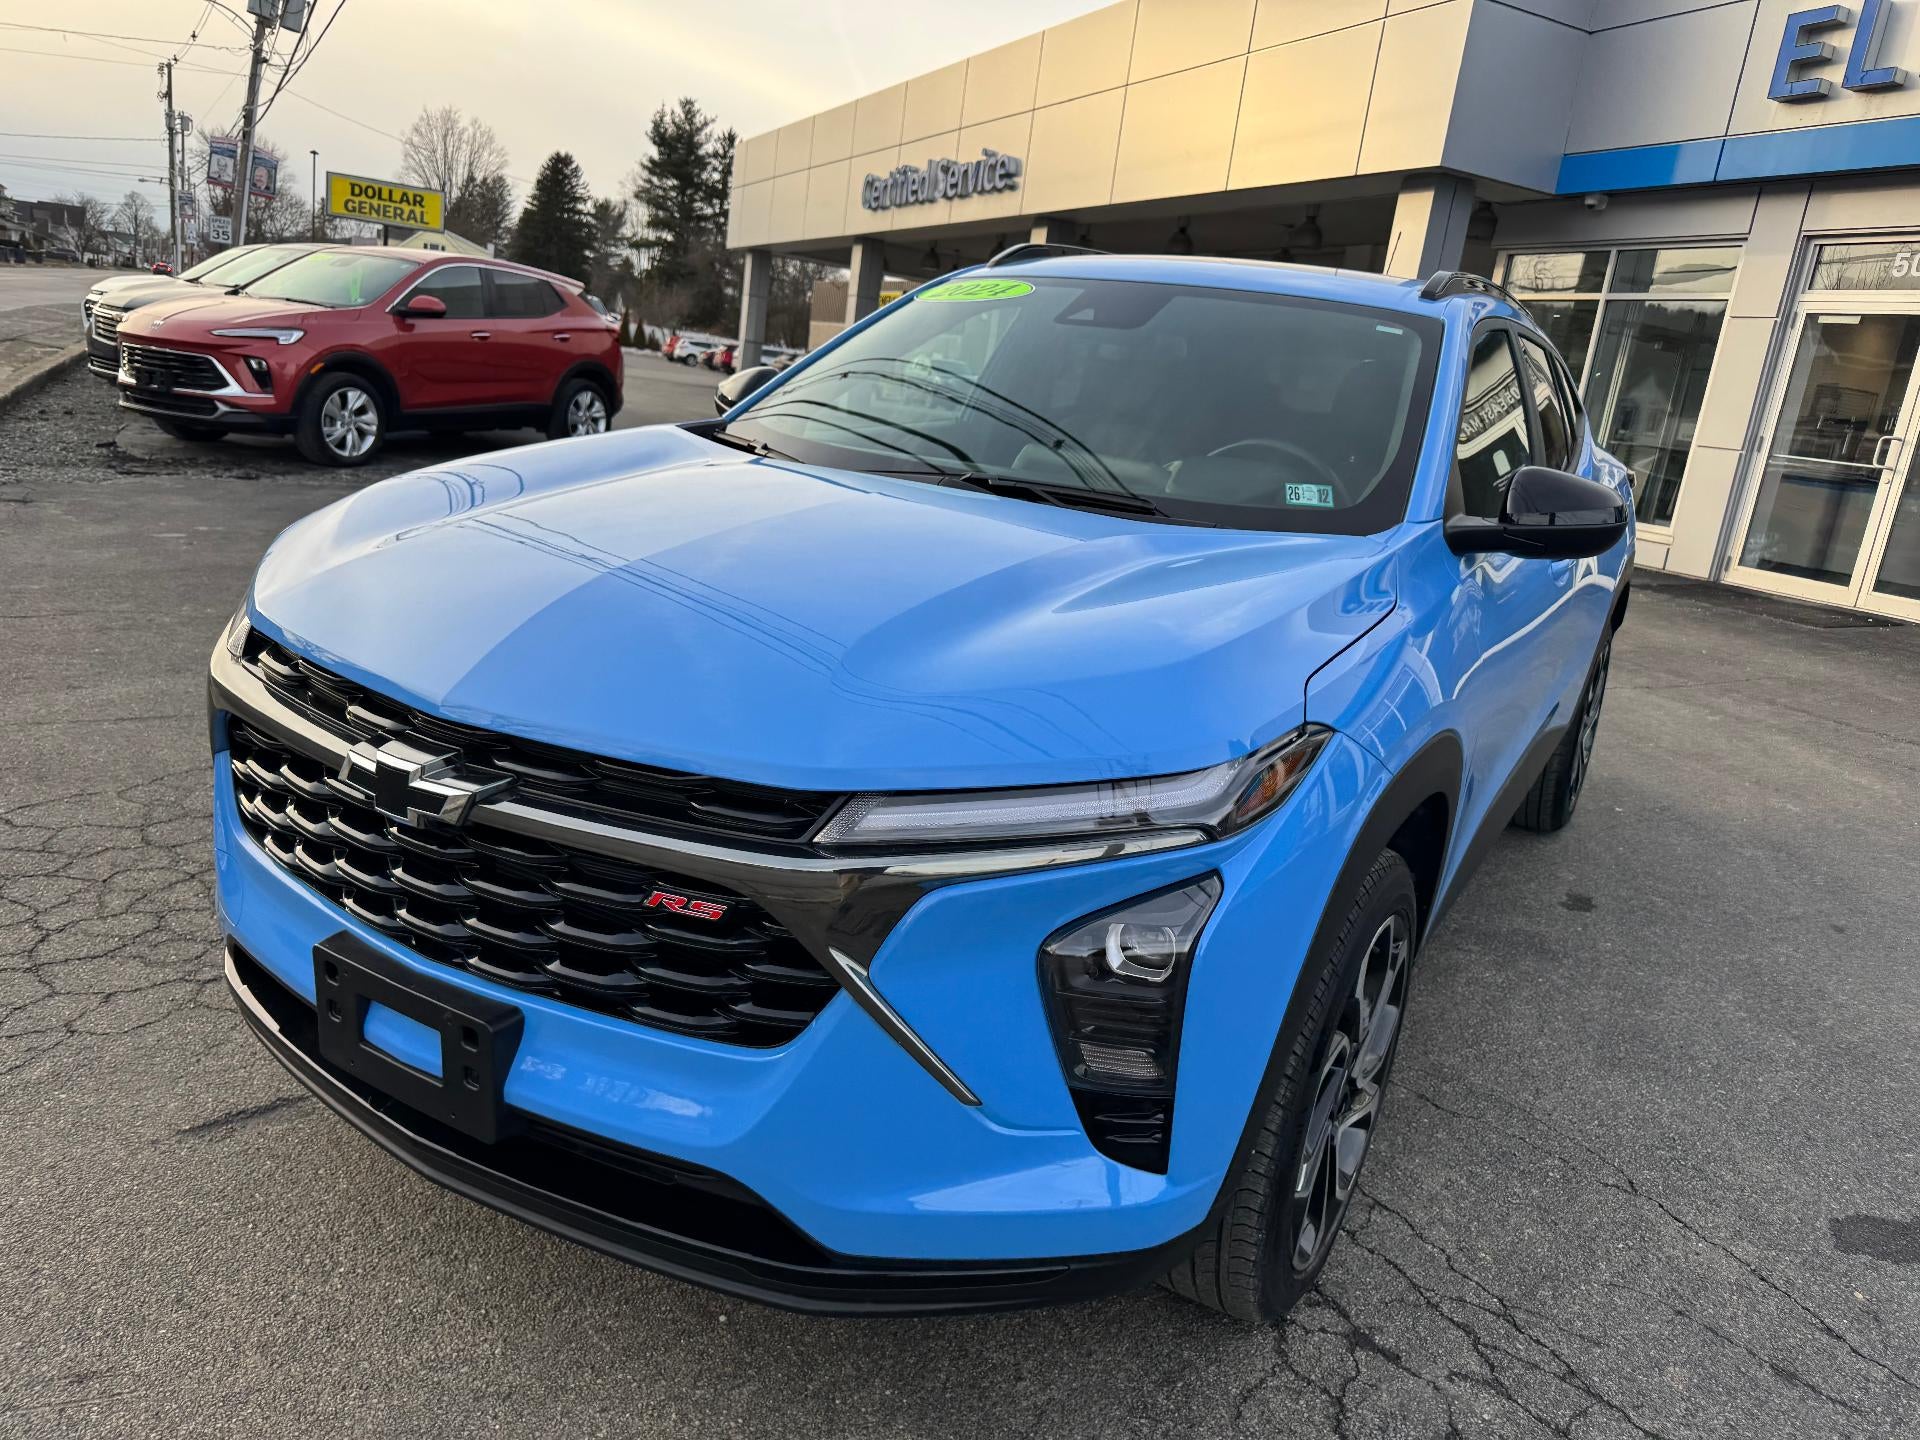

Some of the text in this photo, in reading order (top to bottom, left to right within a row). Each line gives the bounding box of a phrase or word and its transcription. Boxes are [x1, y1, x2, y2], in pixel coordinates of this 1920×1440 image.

[1767, 0, 1908, 103] EL
[862, 148, 1022, 210] Certified Service
[349, 182, 425, 208] DOLLAR
[343, 198, 430, 225] GENERAL
[212, 229, 230, 241] 35
[927, 284, 1022, 298] 2024
[1288, 485, 1300, 501] 26
[1317, 488, 1331, 504] 12
[643, 890, 728, 920] RS
